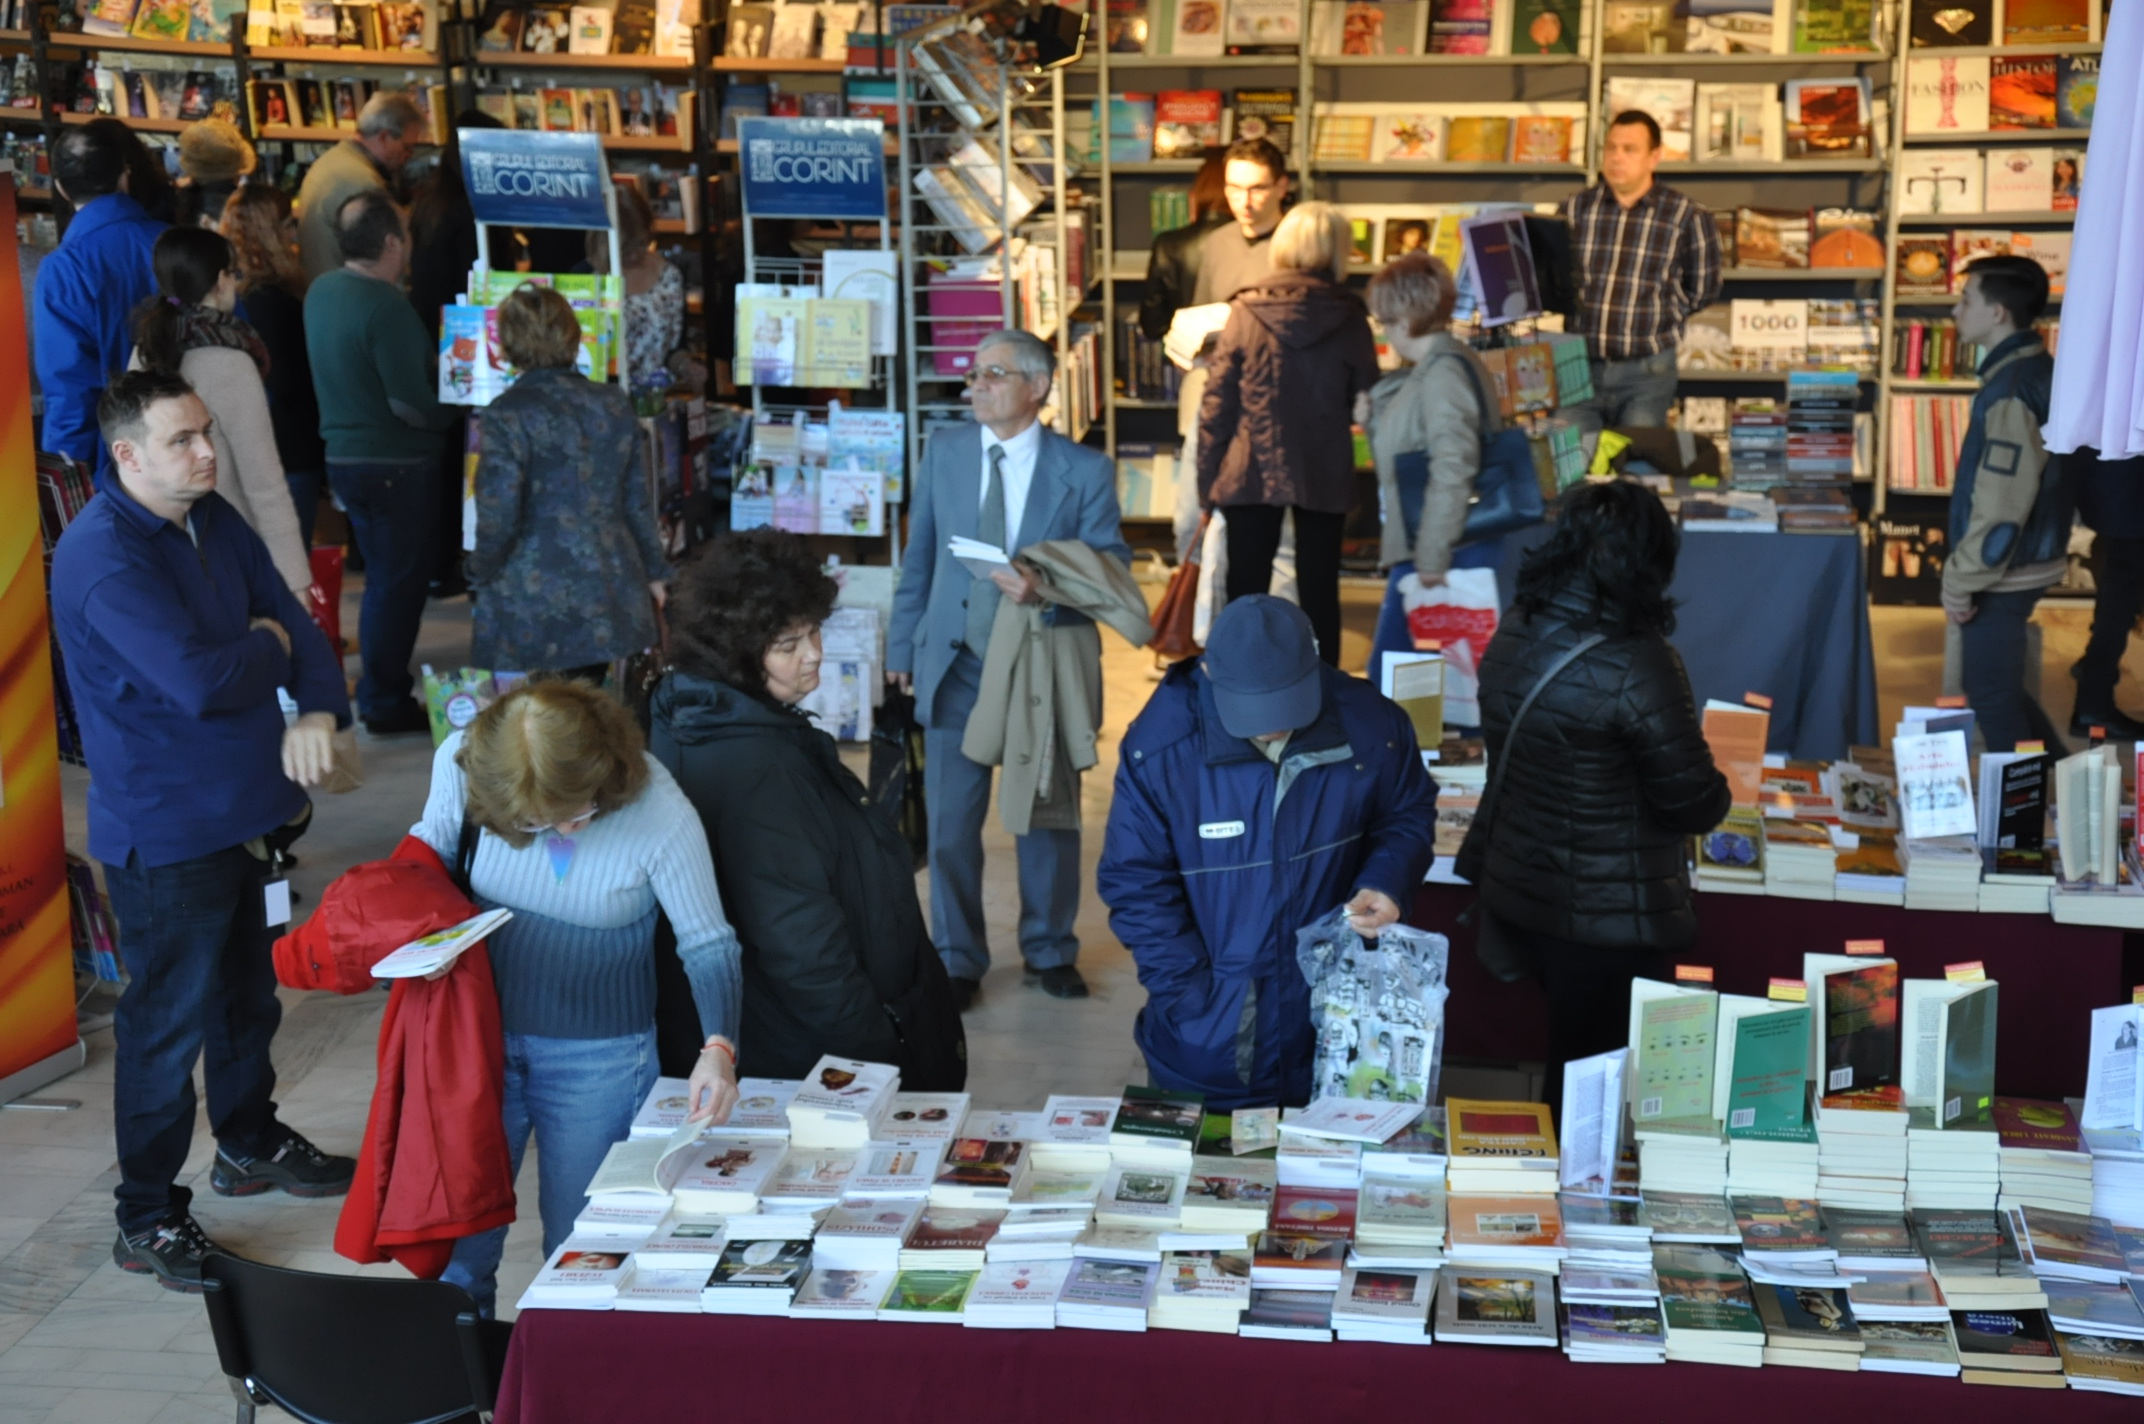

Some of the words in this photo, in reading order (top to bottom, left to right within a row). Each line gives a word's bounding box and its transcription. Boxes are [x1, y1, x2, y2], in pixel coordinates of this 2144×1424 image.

[2070, 58, 2101, 72] ATL
[817, 141, 872, 157] EDITORIAL
[534, 154, 588, 172] EDITORIAL
[773, 156, 874, 185] CORINT
[494, 170, 591, 199] CORINT
[1740, 314, 1798, 330] 1000
[909, 1238, 984, 1248] DIABETUL
[1351, 1297, 1390, 1307] bolnav
[1391, 1300, 1421, 1309] Omul
